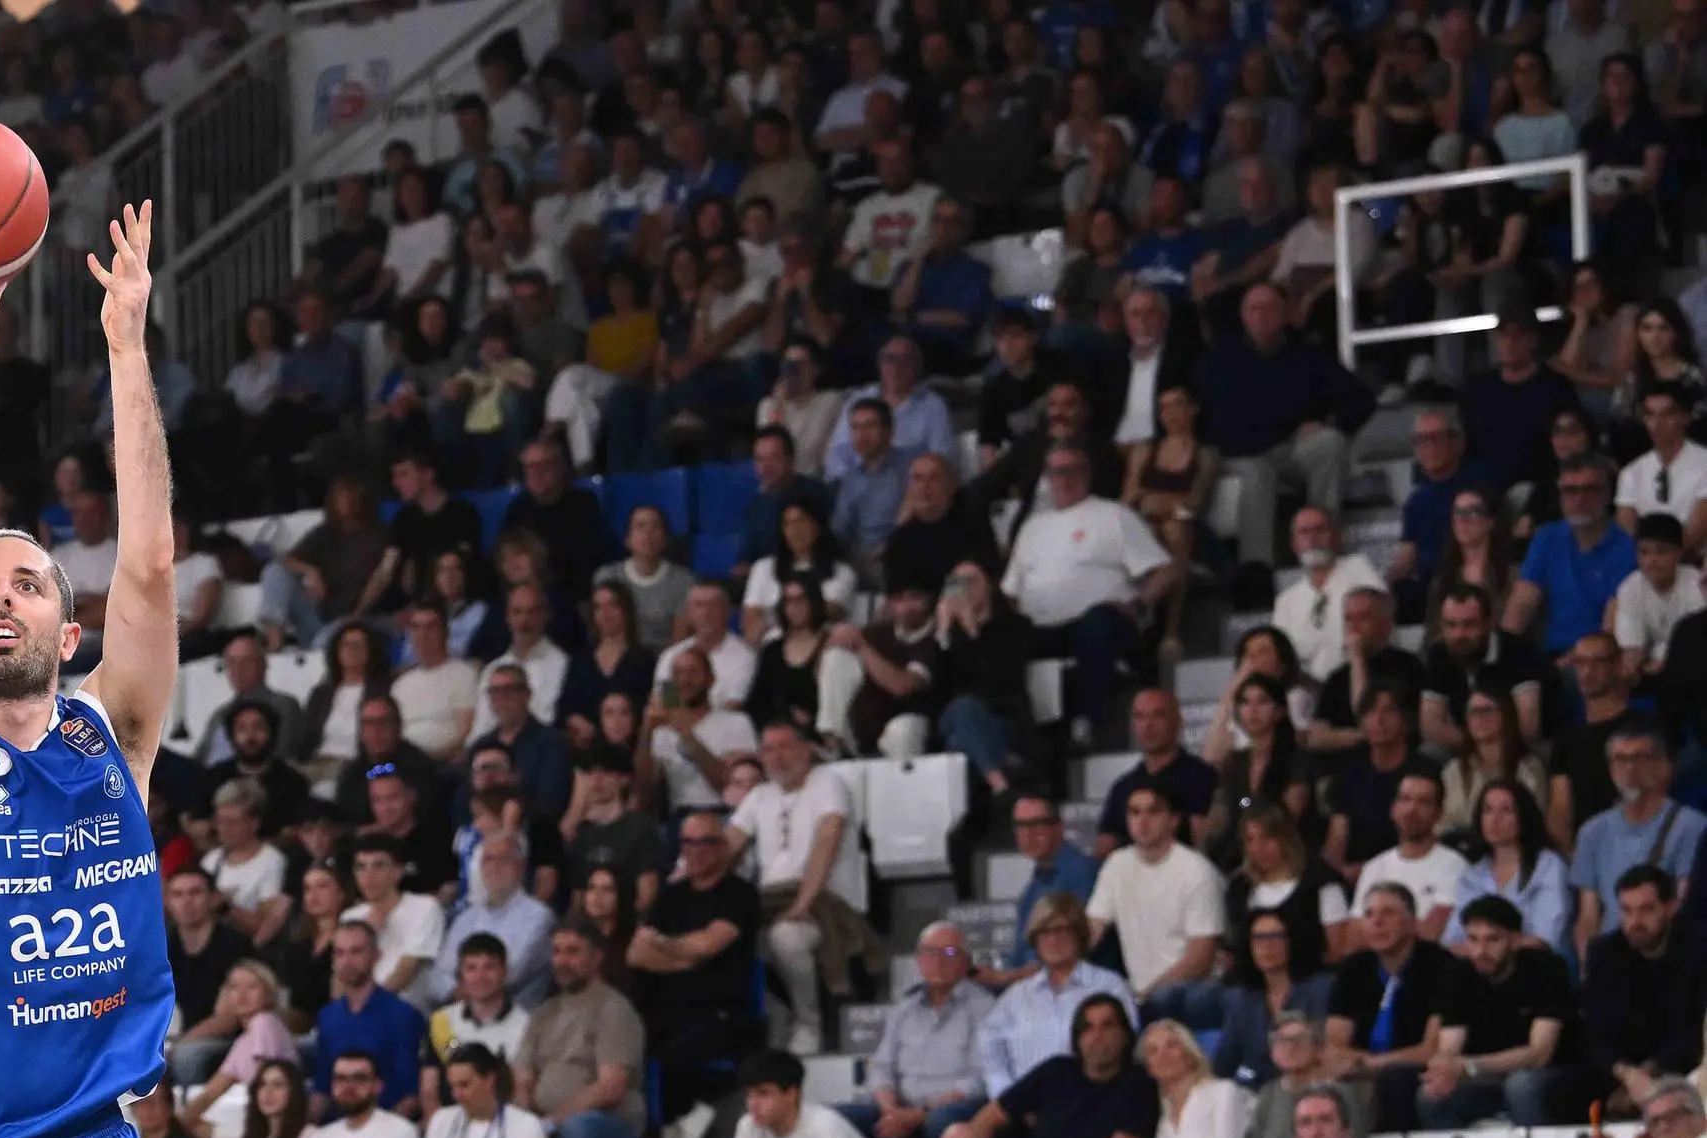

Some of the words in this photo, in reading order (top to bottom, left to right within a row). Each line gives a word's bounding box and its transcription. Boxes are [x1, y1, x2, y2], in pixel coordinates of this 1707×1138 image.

[74, 727, 94, 744] LBA
[9, 903, 125, 962] a2a
[13, 968, 46, 984] LIFE
[51, 955, 126, 980] COMPANY
[7, 986, 127, 1026] Humangest
